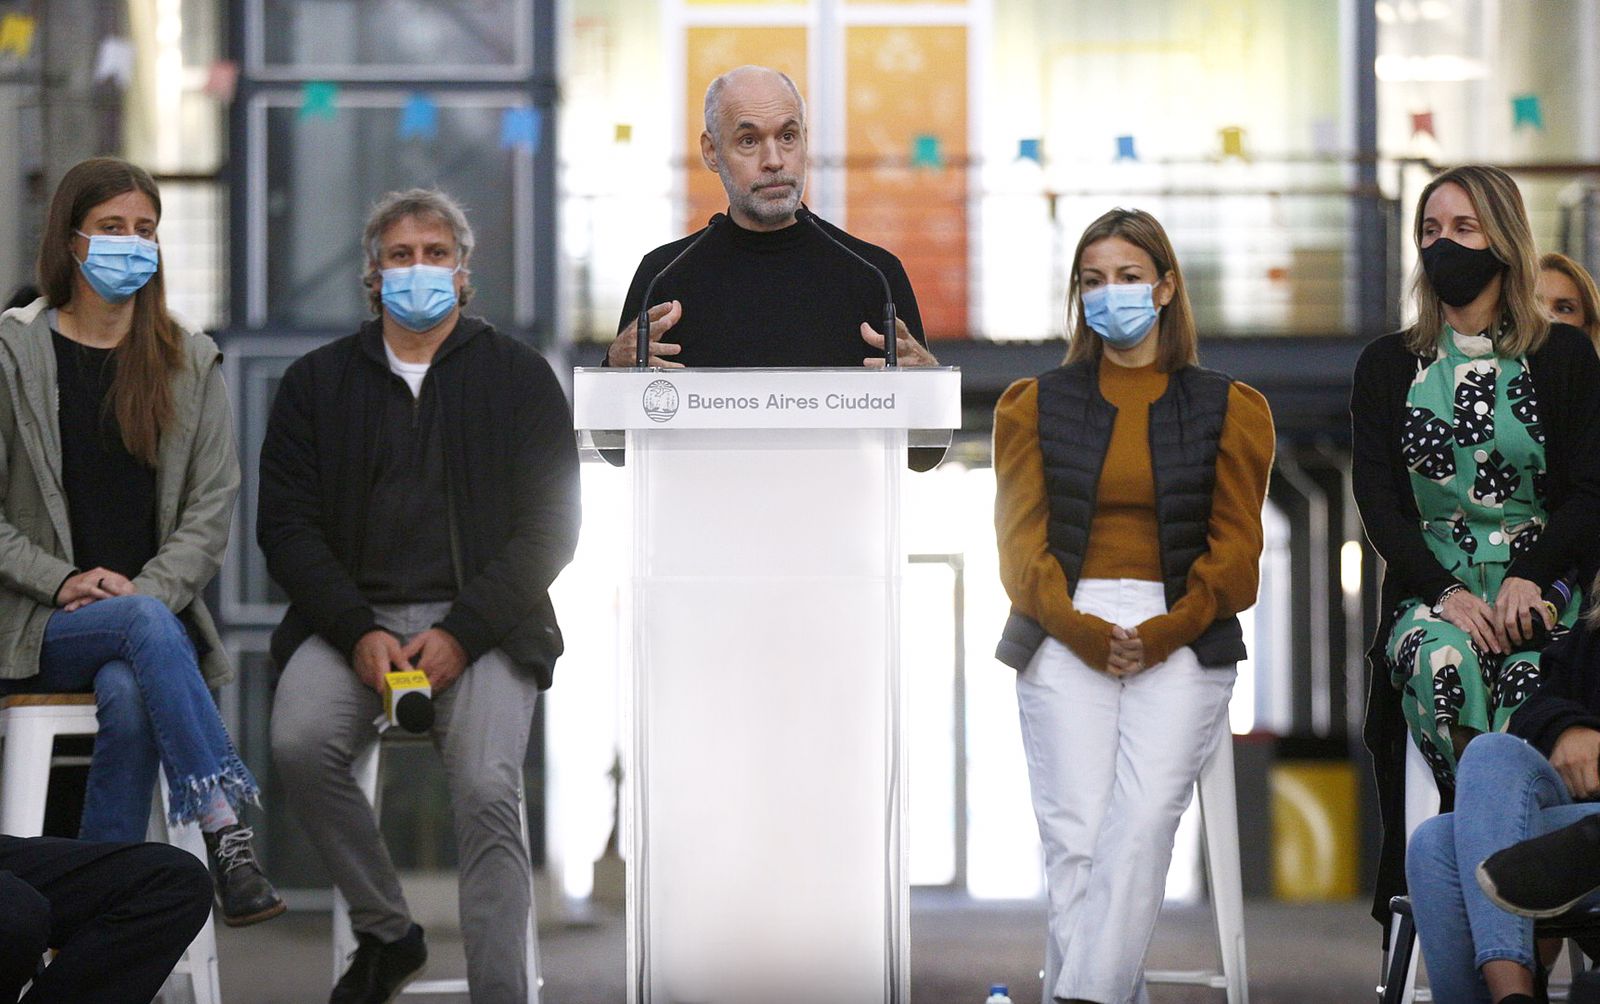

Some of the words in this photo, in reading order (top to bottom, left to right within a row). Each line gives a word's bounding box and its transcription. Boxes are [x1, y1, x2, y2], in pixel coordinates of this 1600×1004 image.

[687, 393, 760, 410] Buenos
[765, 393, 819, 410] Aires
[825, 393, 896, 410] Ciudad
